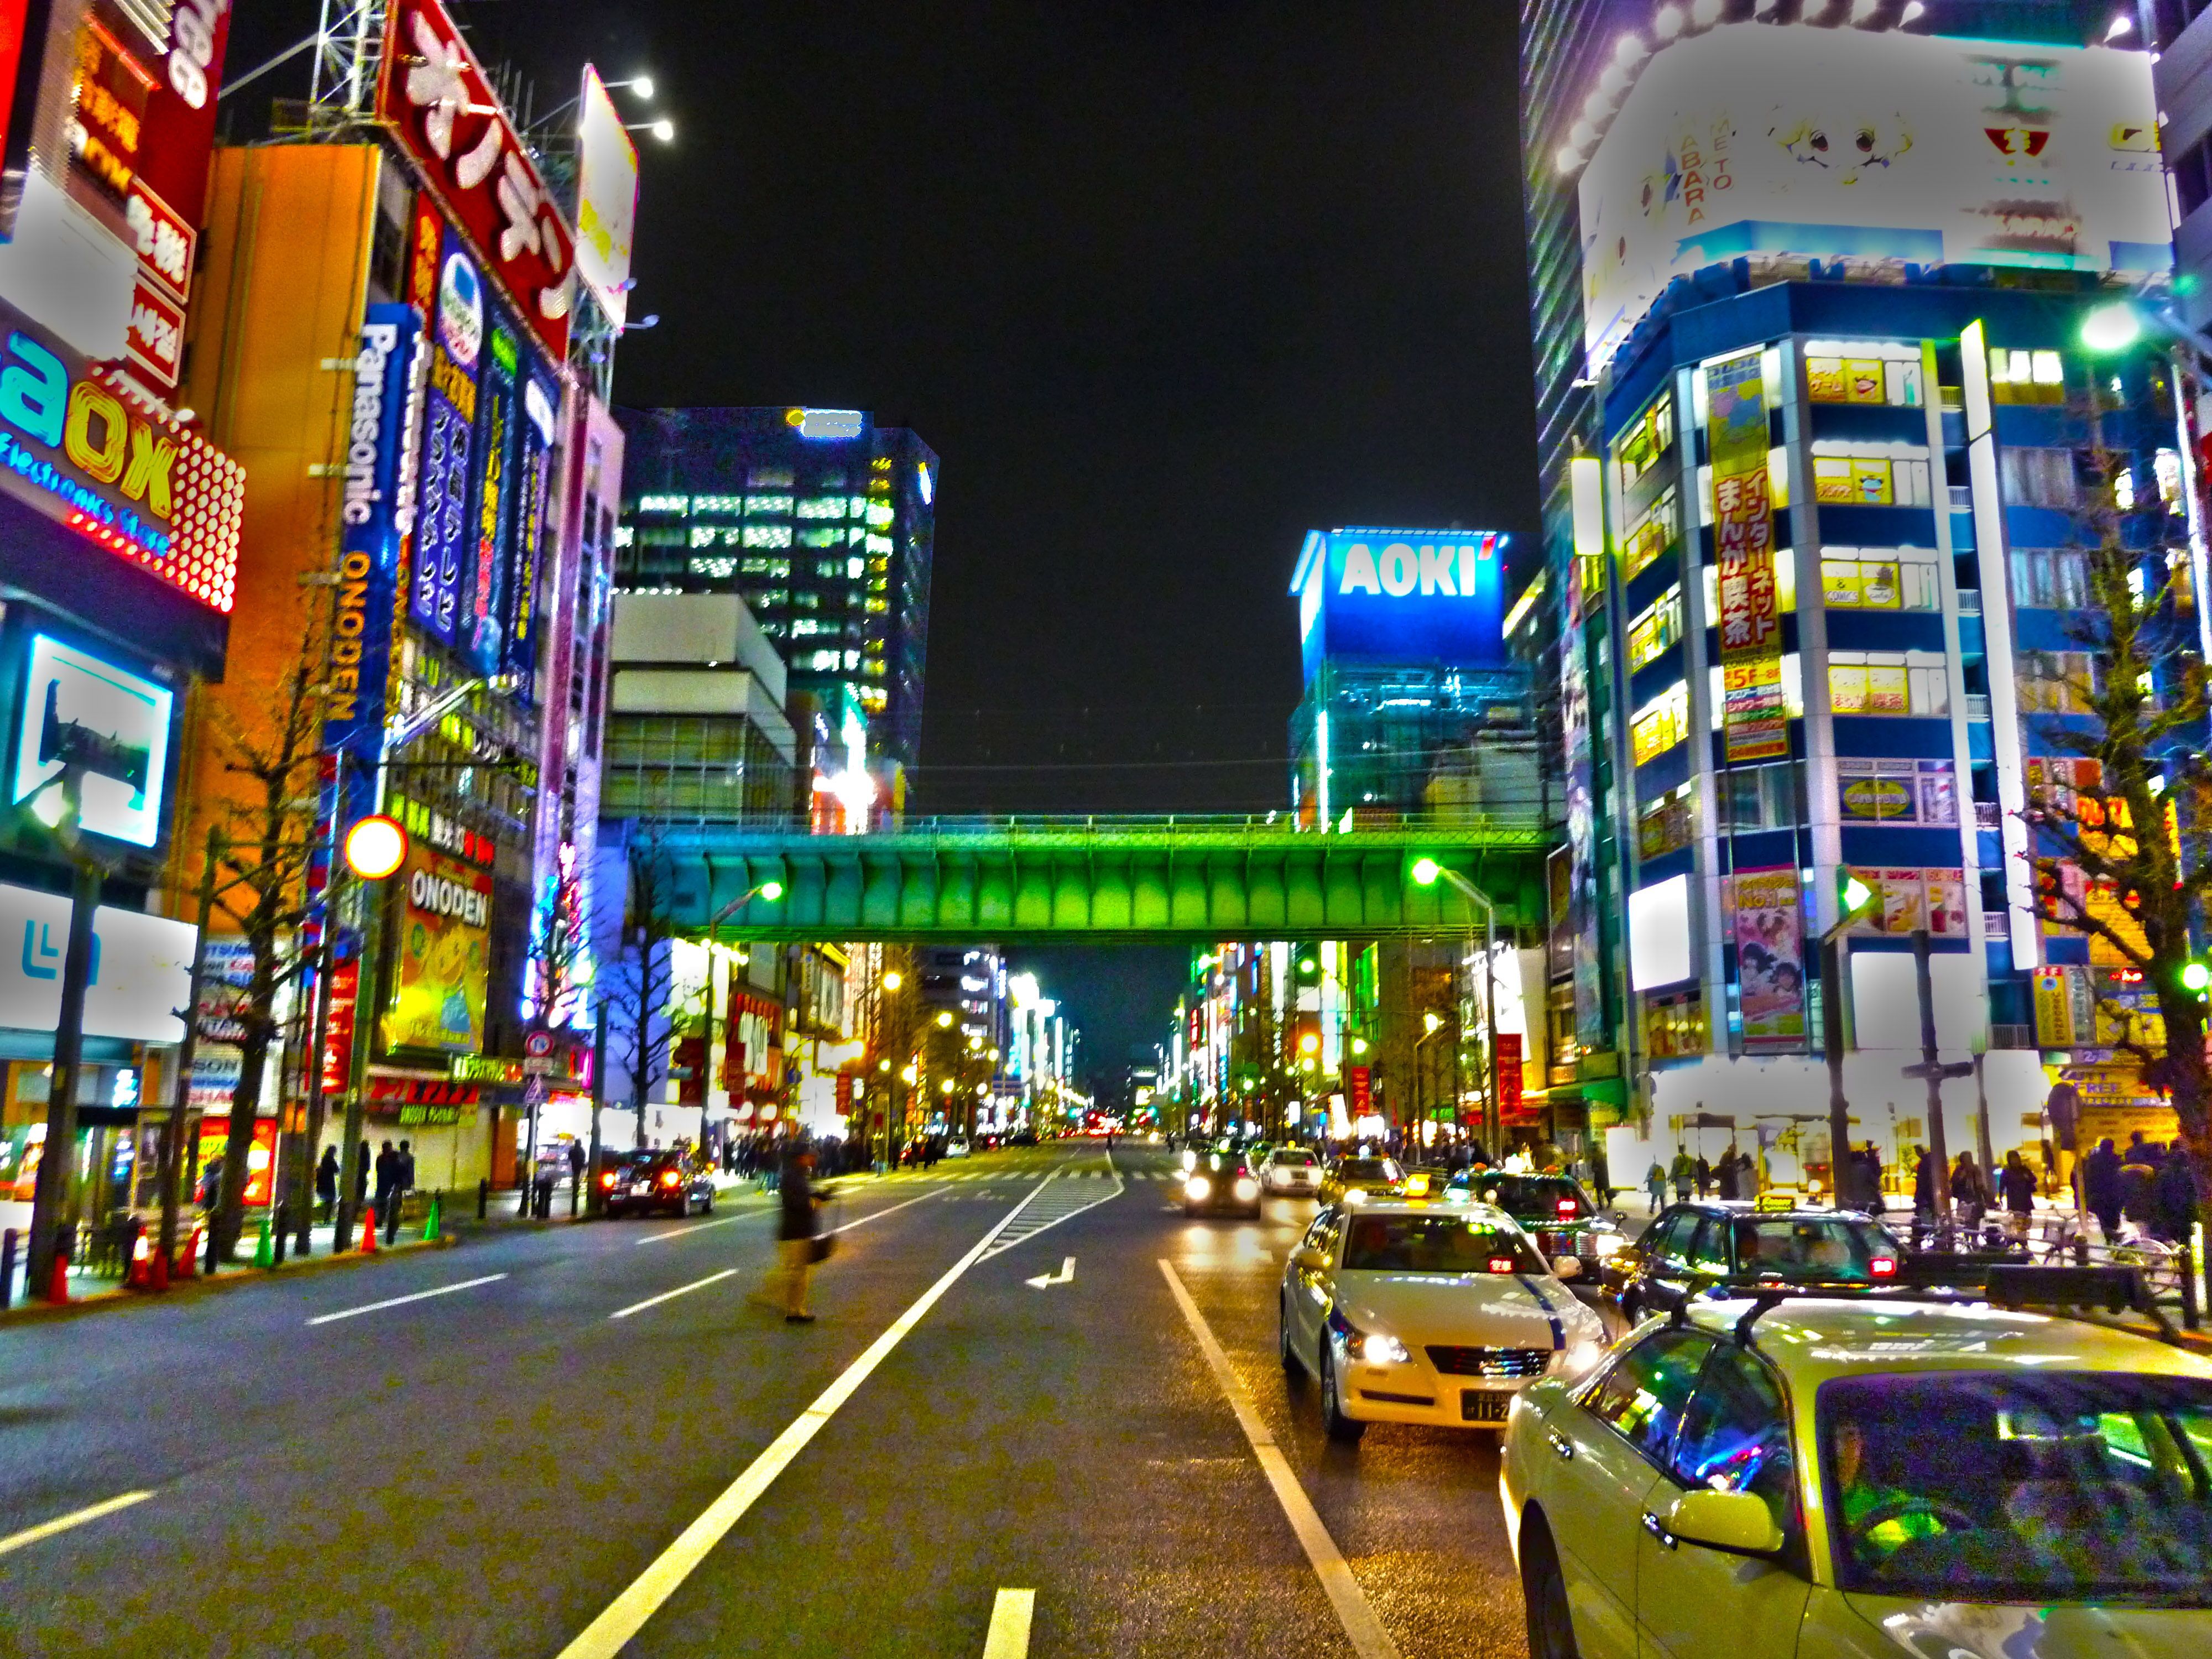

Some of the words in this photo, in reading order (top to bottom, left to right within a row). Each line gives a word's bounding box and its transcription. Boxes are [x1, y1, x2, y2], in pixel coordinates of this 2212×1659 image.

[343, 323, 398, 525] Panasonic
[1338, 543, 1476, 597] AOKI
[327, 550, 372, 721] ONODEN
[411, 867, 488, 928] ONODEN
